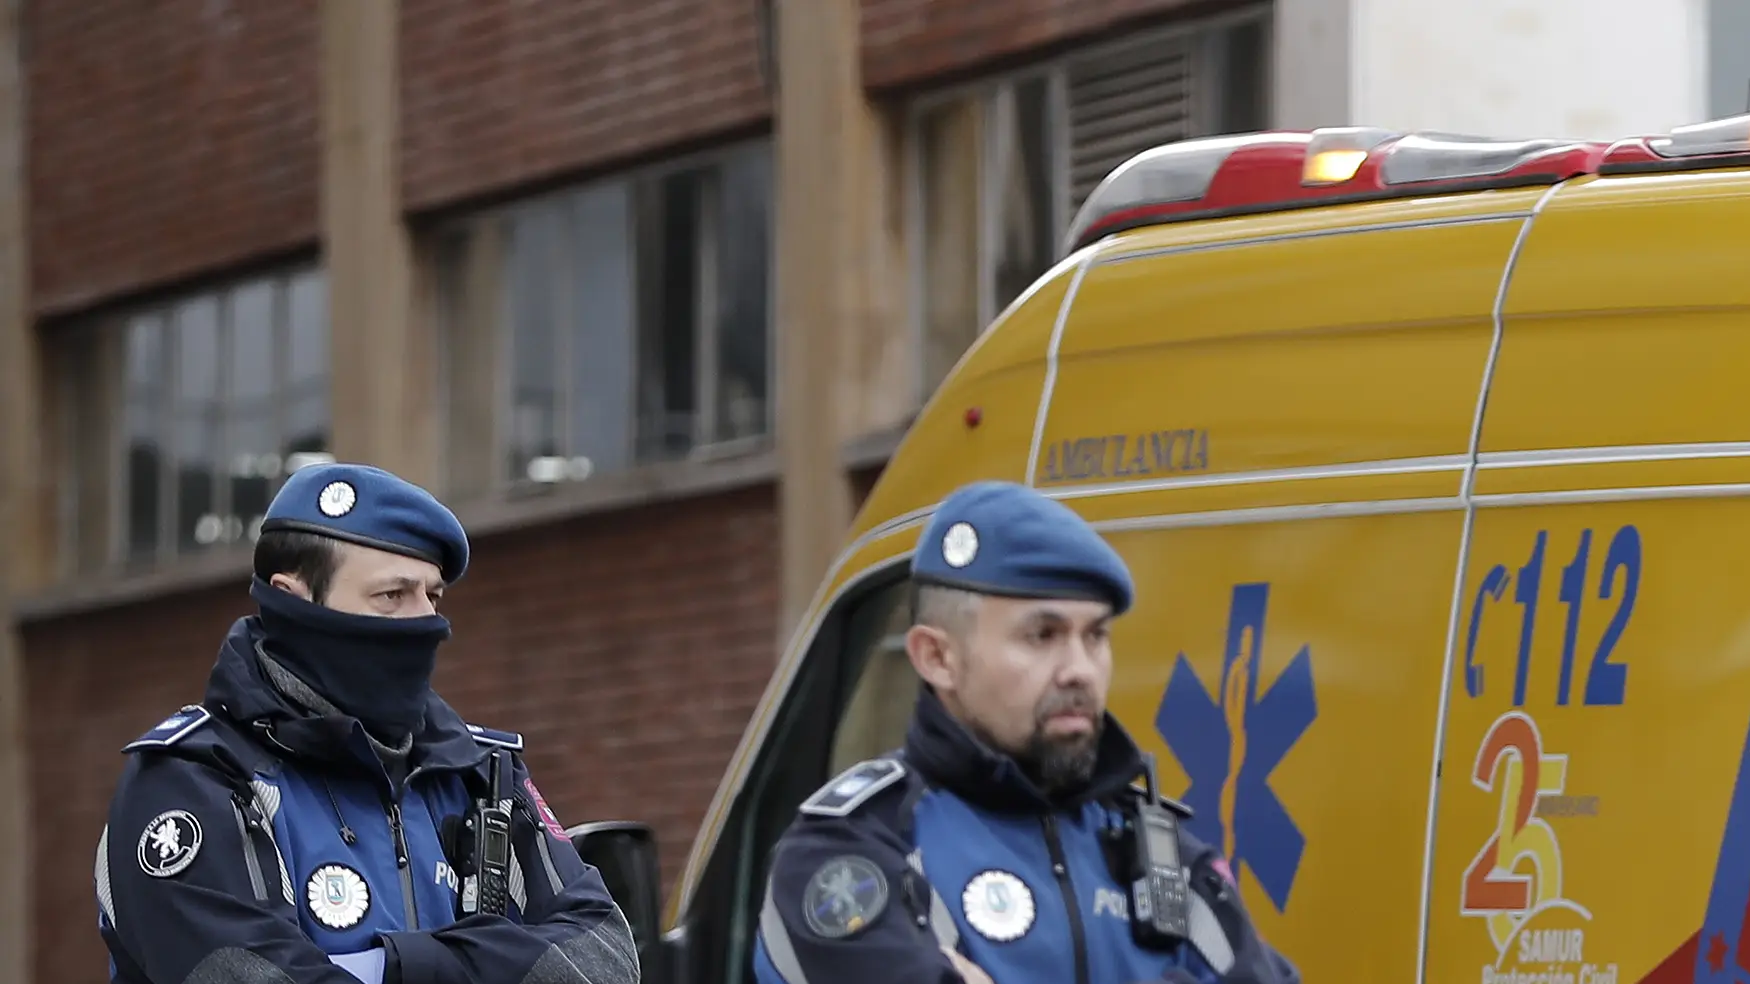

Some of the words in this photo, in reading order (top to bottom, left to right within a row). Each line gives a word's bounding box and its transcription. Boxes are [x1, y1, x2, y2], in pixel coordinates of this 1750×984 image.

[1039, 428, 1209, 481] AMBULANCIA
[1512, 524, 1642, 706] 112
[1518, 929, 1584, 963] SAMUR
